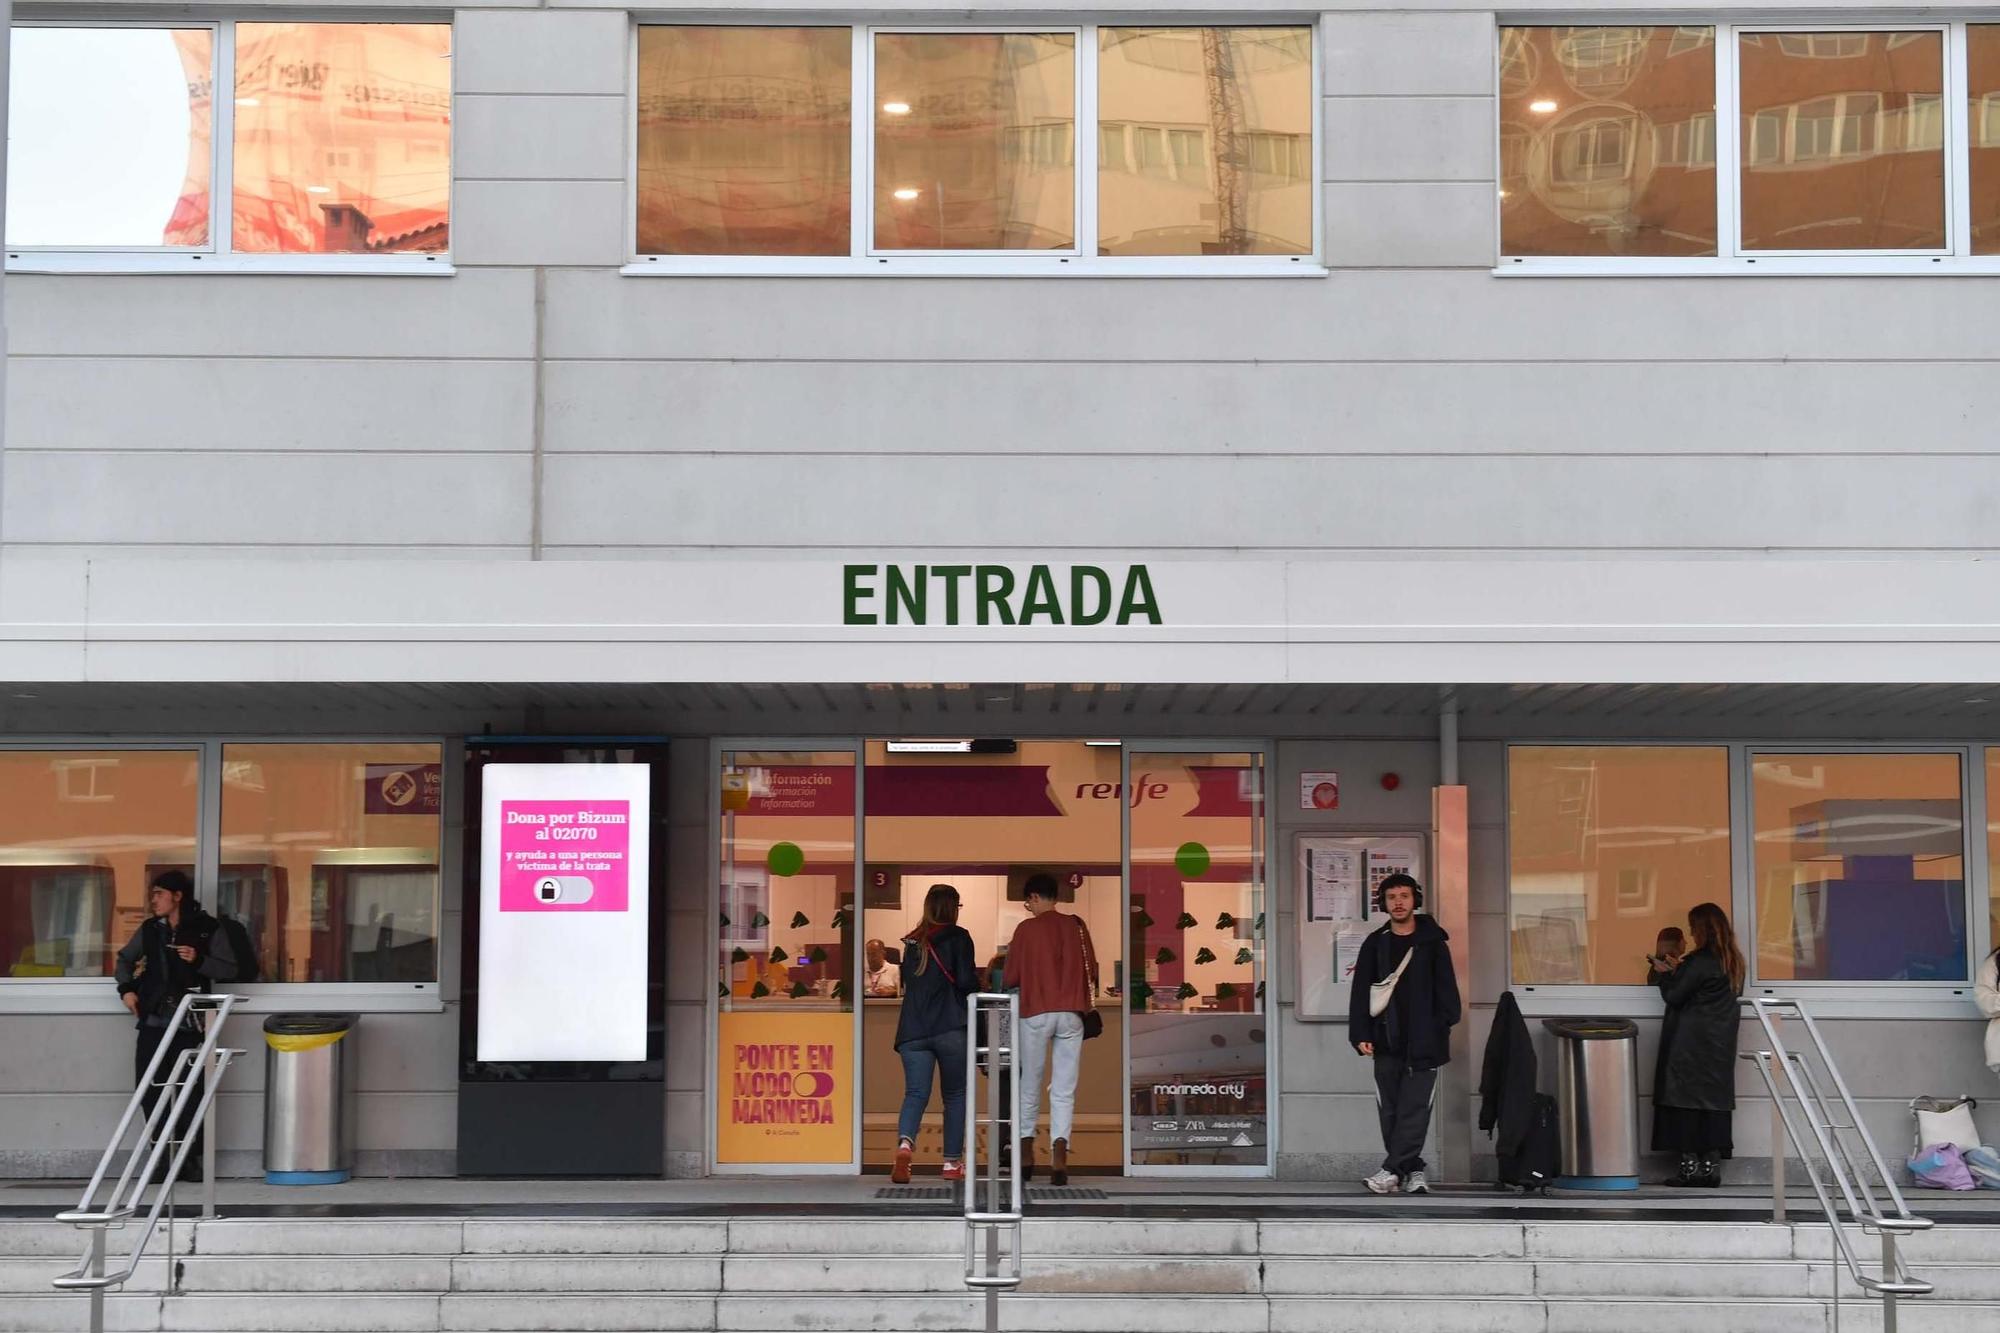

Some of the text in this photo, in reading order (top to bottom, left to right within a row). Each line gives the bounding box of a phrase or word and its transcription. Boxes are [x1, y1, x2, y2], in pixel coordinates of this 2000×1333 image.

[844, 564, 1163, 626] ENTRADA
[1076, 773, 1168, 808] renfe
[761, 799, 815, 810] Information
[507, 811, 626, 826] Dona por Bizum
[535, 827, 597, 840] al 02070
[506, 852, 513, 861] y
[515, 850, 547, 861] ayuda
[580, 852, 623, 861] persona
[517, 861, 611, 871] víctima de la trata
[876, 873, 886, 886] 3
[1069, 873, 1079, 886] 4
[734, 1044, 833, 1070] PONTE EN
[733, 1072, 792, 1098] MODO
[1154, 1083, 1245, 1099] marineda city
[732, 1099, 834, 1124] MARINEDA
